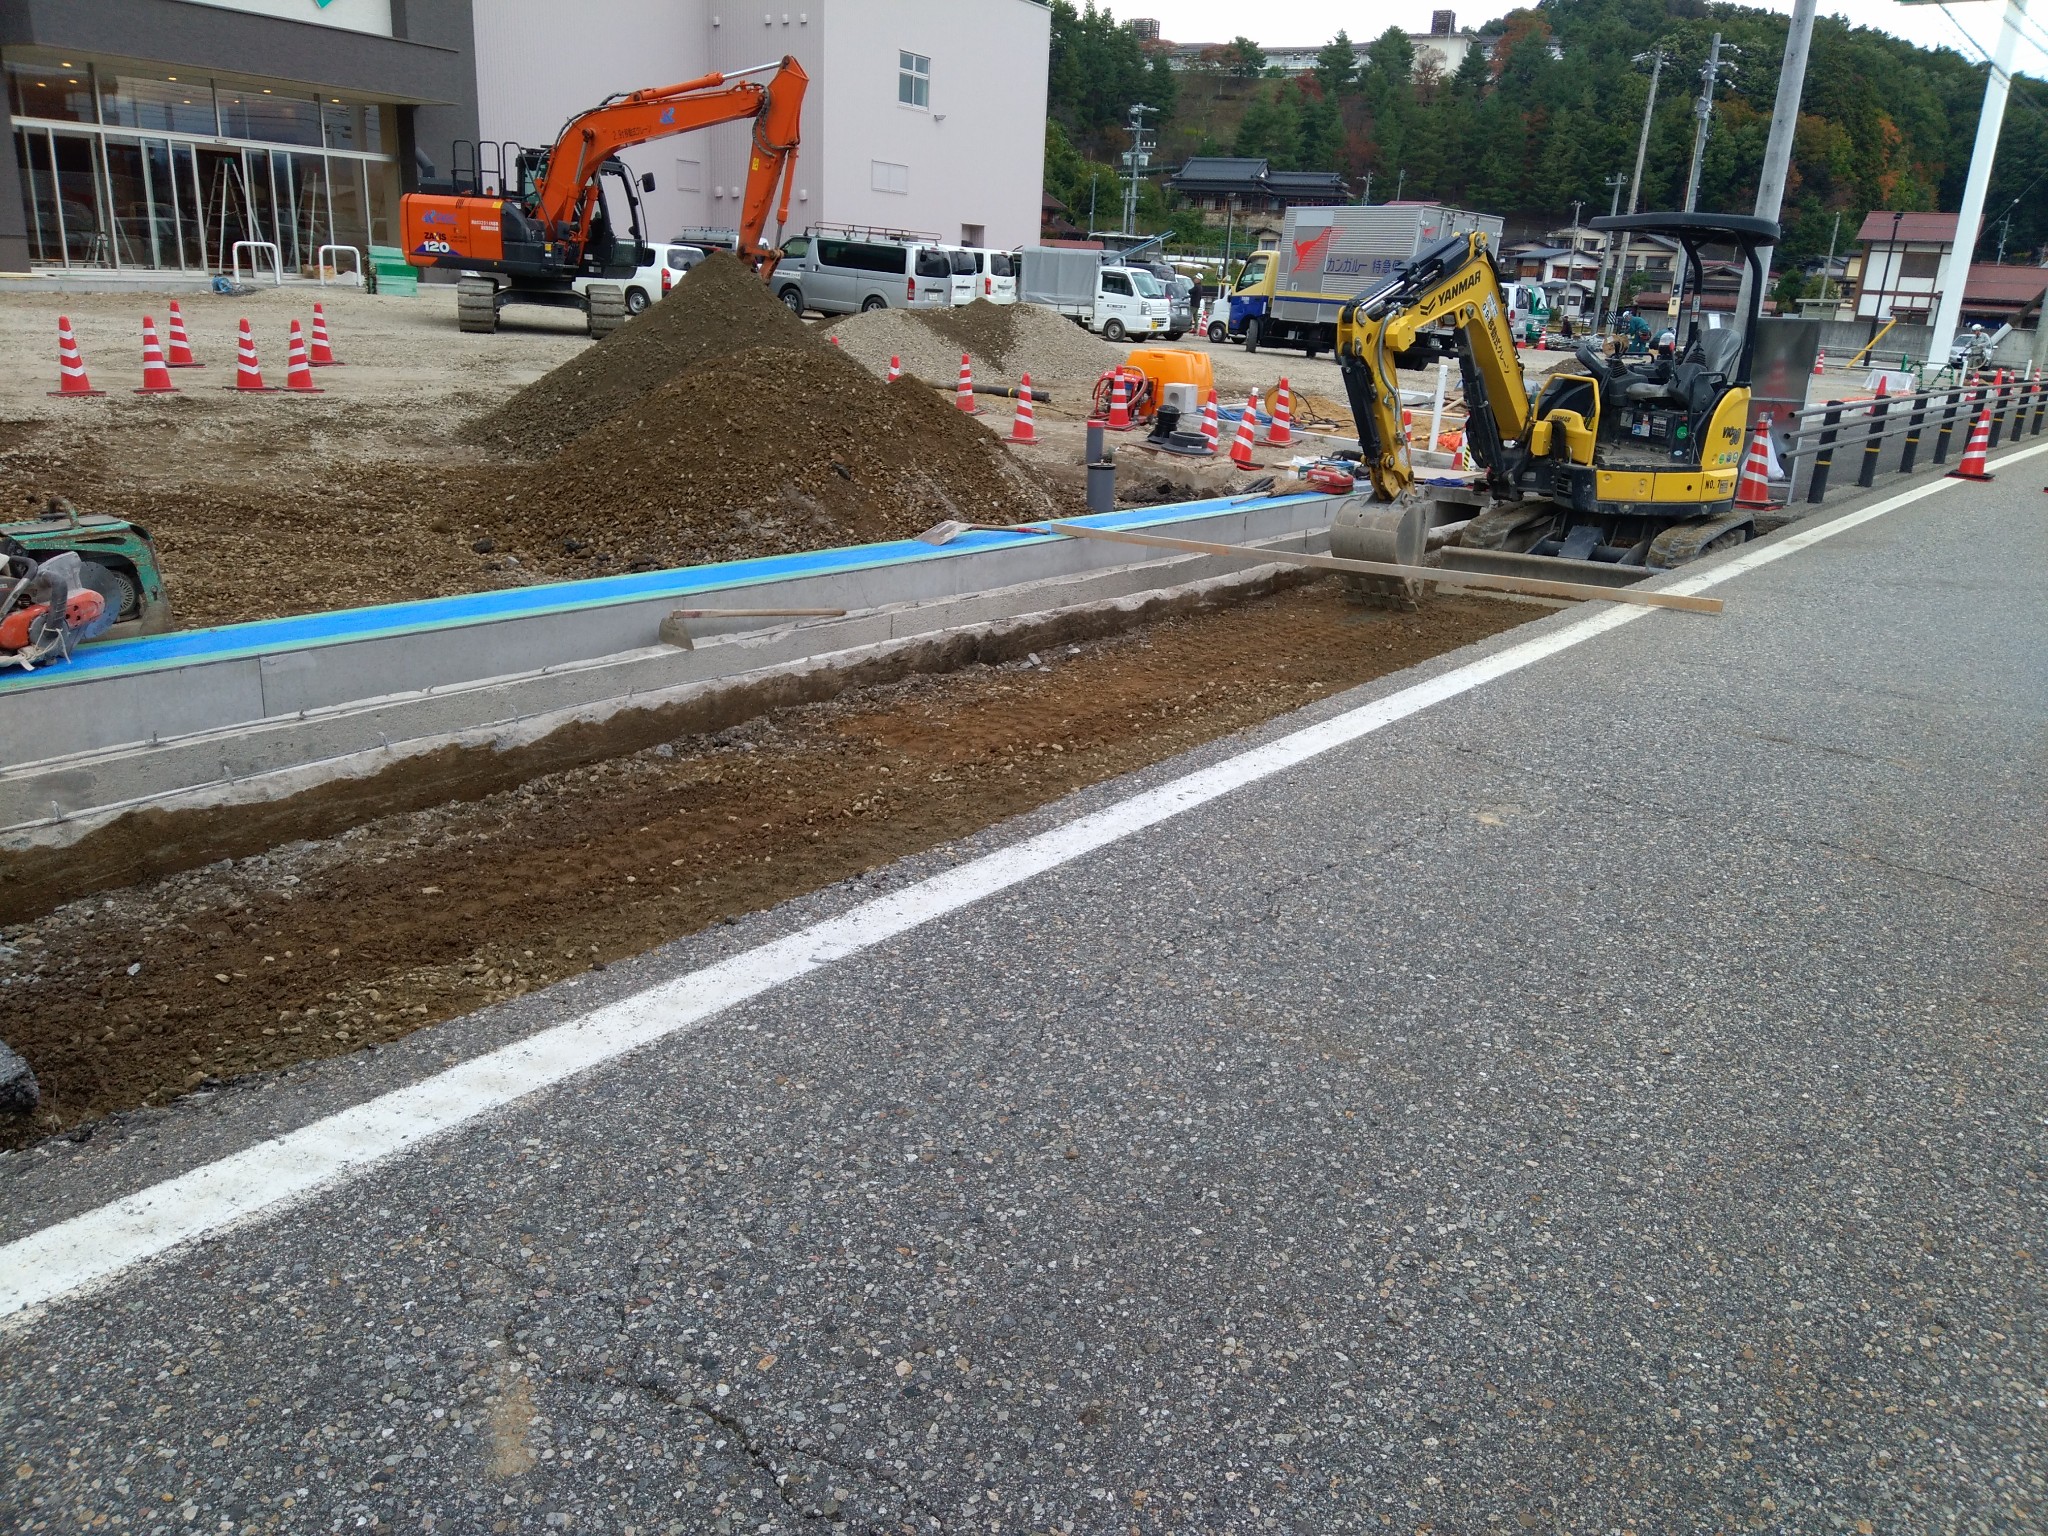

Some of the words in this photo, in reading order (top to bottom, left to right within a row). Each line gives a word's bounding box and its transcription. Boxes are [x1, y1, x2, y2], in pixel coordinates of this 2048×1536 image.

[423, 240, 450, 253] 120
[1326, 257, 1368, 273] カンガルー
[1438, 270, 1481, 306] YANMAR
[1551, 414, 1571, 423] YANMAR
